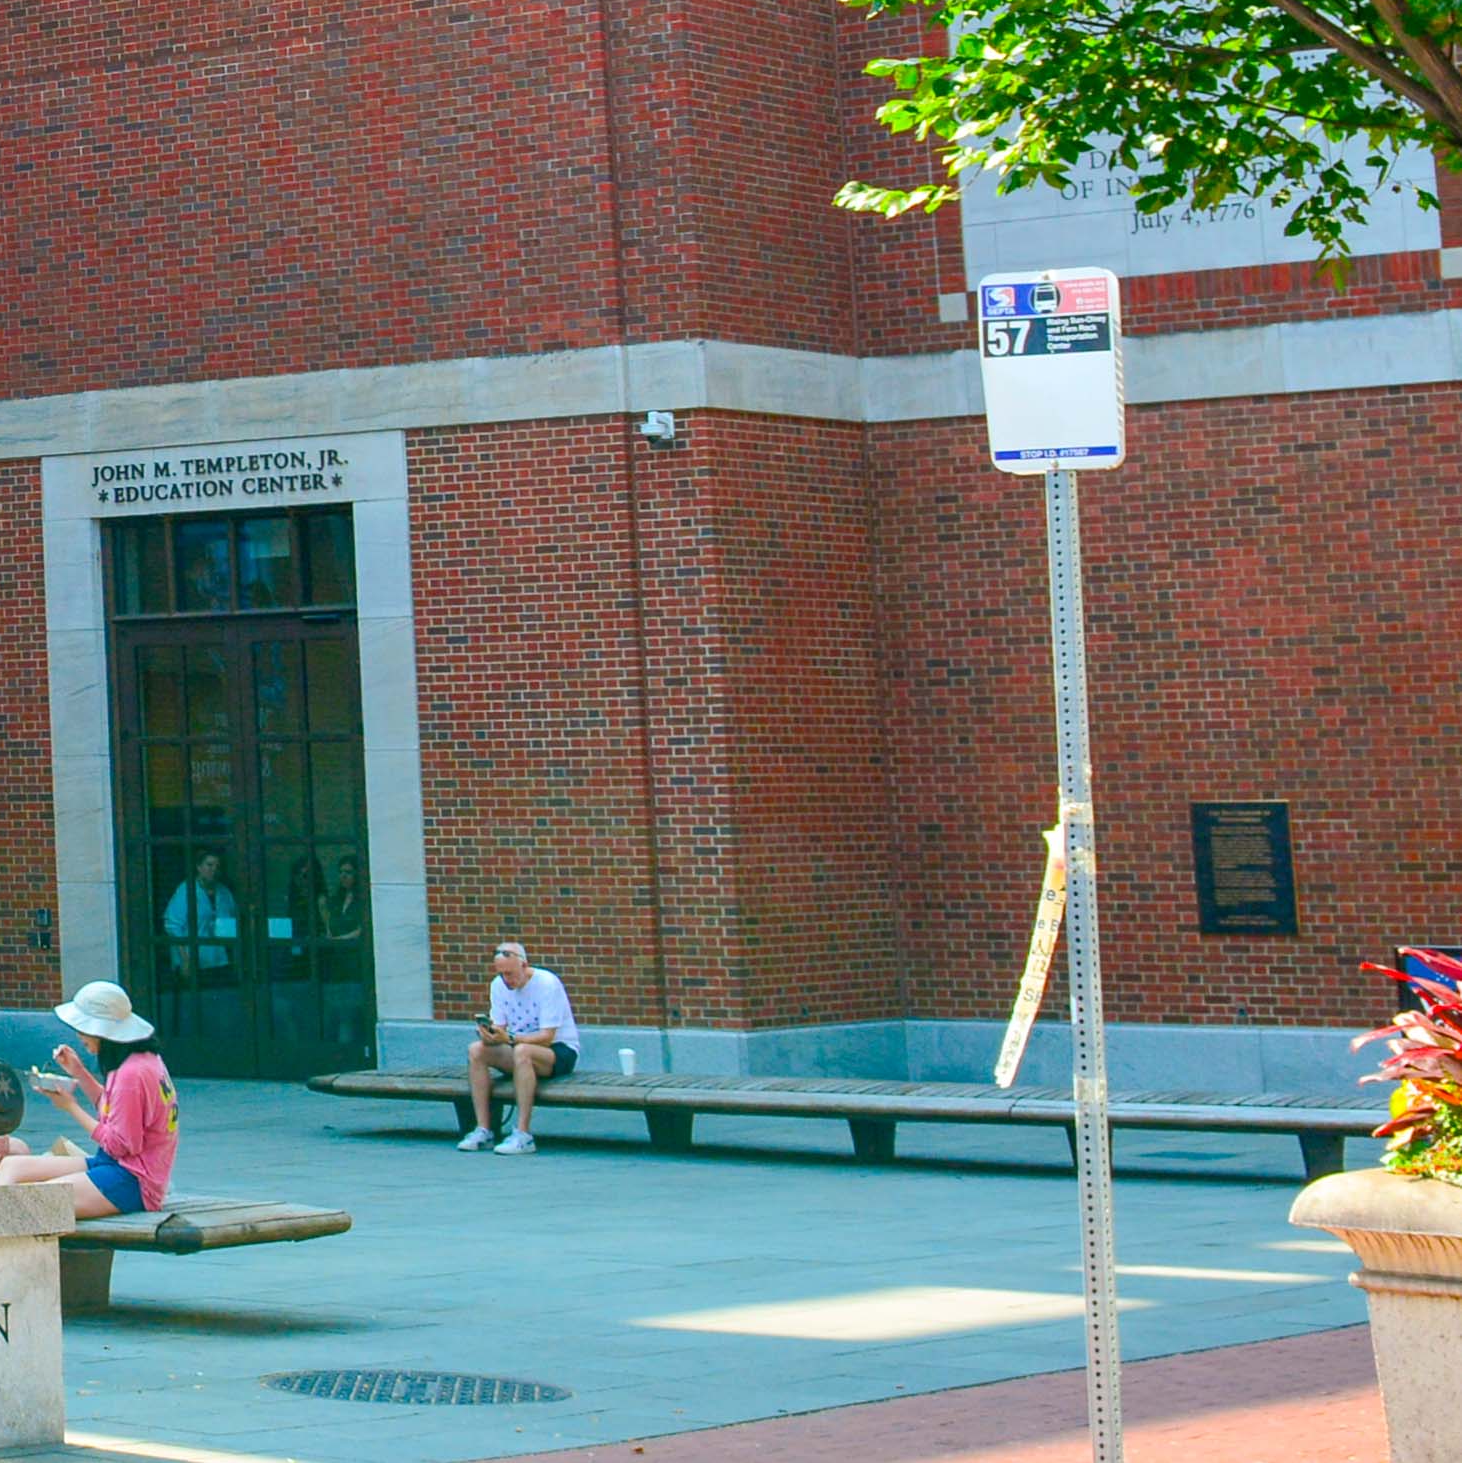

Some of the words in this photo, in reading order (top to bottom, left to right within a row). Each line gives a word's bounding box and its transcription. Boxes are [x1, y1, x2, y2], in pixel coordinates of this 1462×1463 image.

[1060, 180, 1093, 201] OF
[1131, 213, 1173, 234] July
[1179, 208, 1201, 226] 4,
[1208, 202, 1256, 223] 1776
[987, 320, 1031, 356] 57
[92, 463, 145, 486] JOHN
[153, 461, 177, 478] M.
[180, 451, 312, 476] TEMPLETON,
[316, 449, 349, 471] JR.
[114, 479, 233, 503] EDUCATION
[242, 473, 328, 495] CENTER
